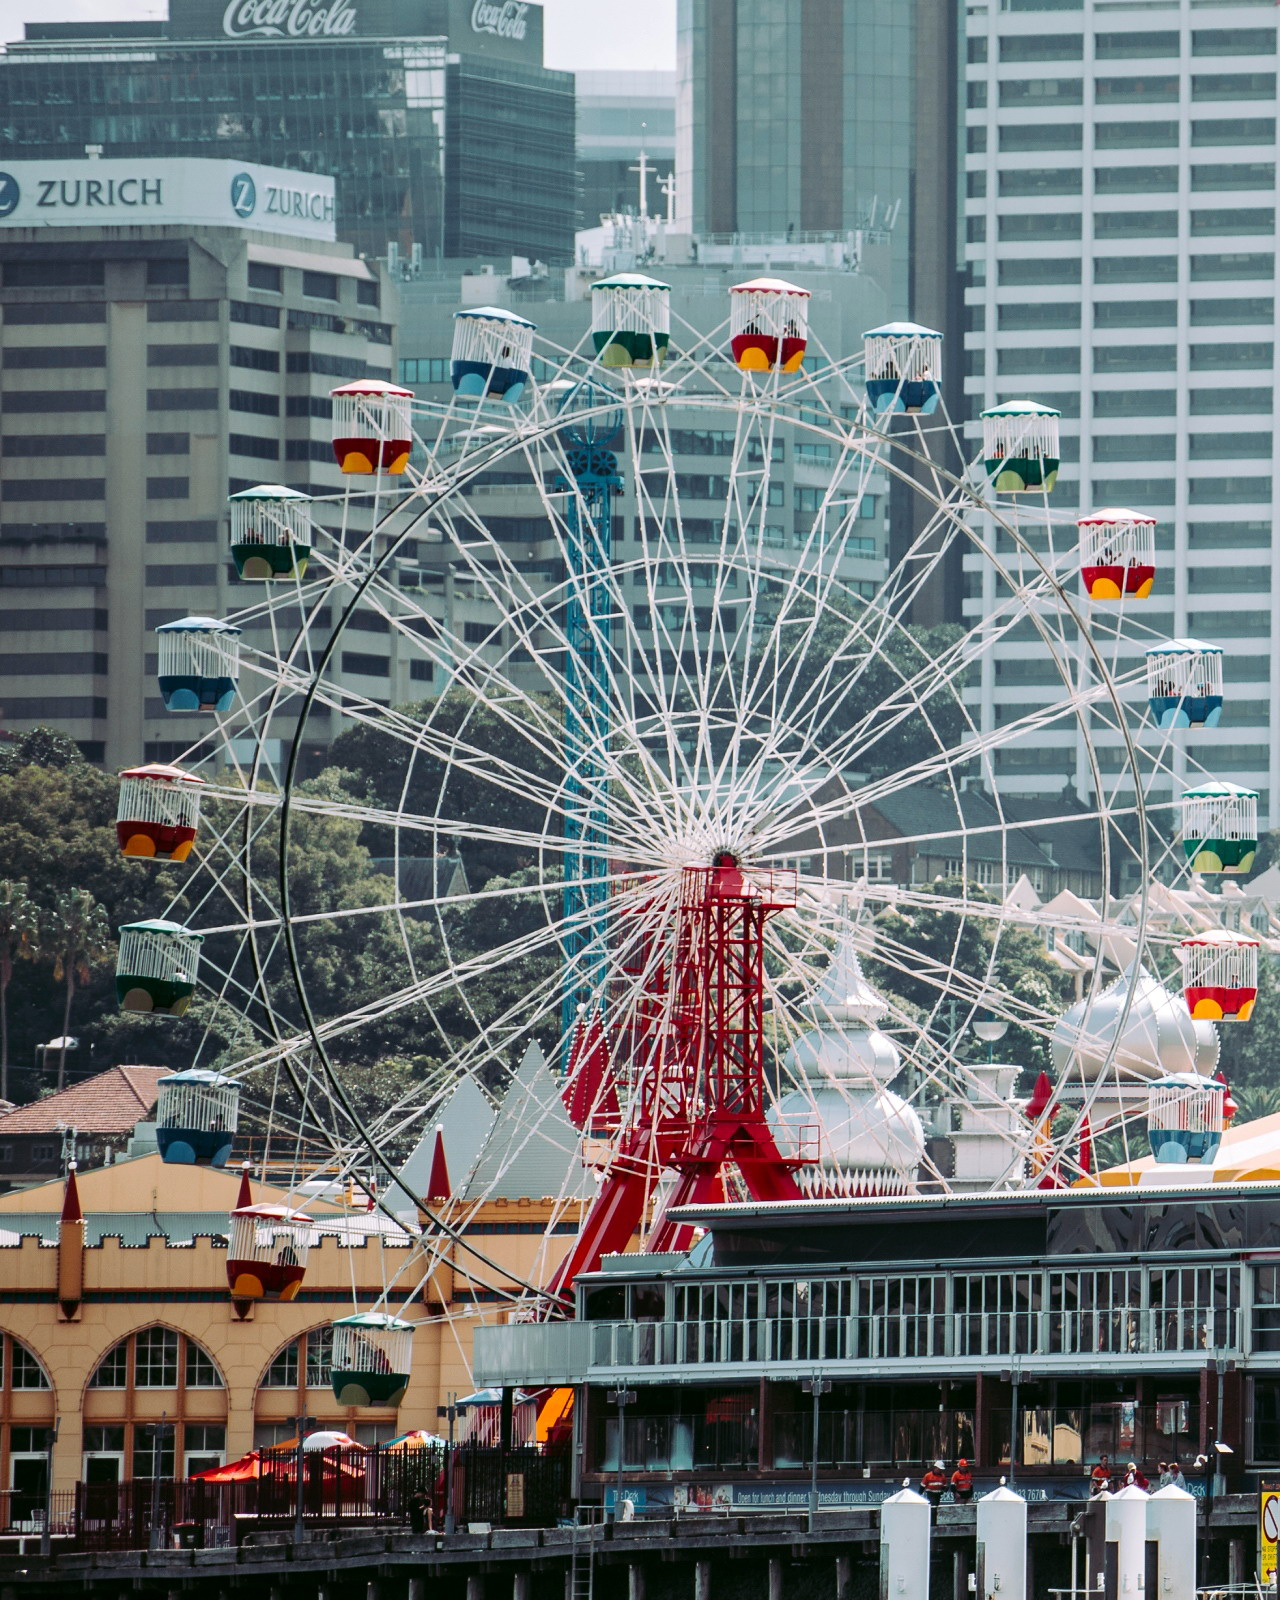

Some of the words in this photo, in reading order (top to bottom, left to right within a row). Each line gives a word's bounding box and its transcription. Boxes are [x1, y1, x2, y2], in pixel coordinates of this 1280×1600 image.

[36, 179, 163, 206] ZURICH
[264, 187, 336, 222] ZURICH
[808, 1491, 842, 1504] nesday
